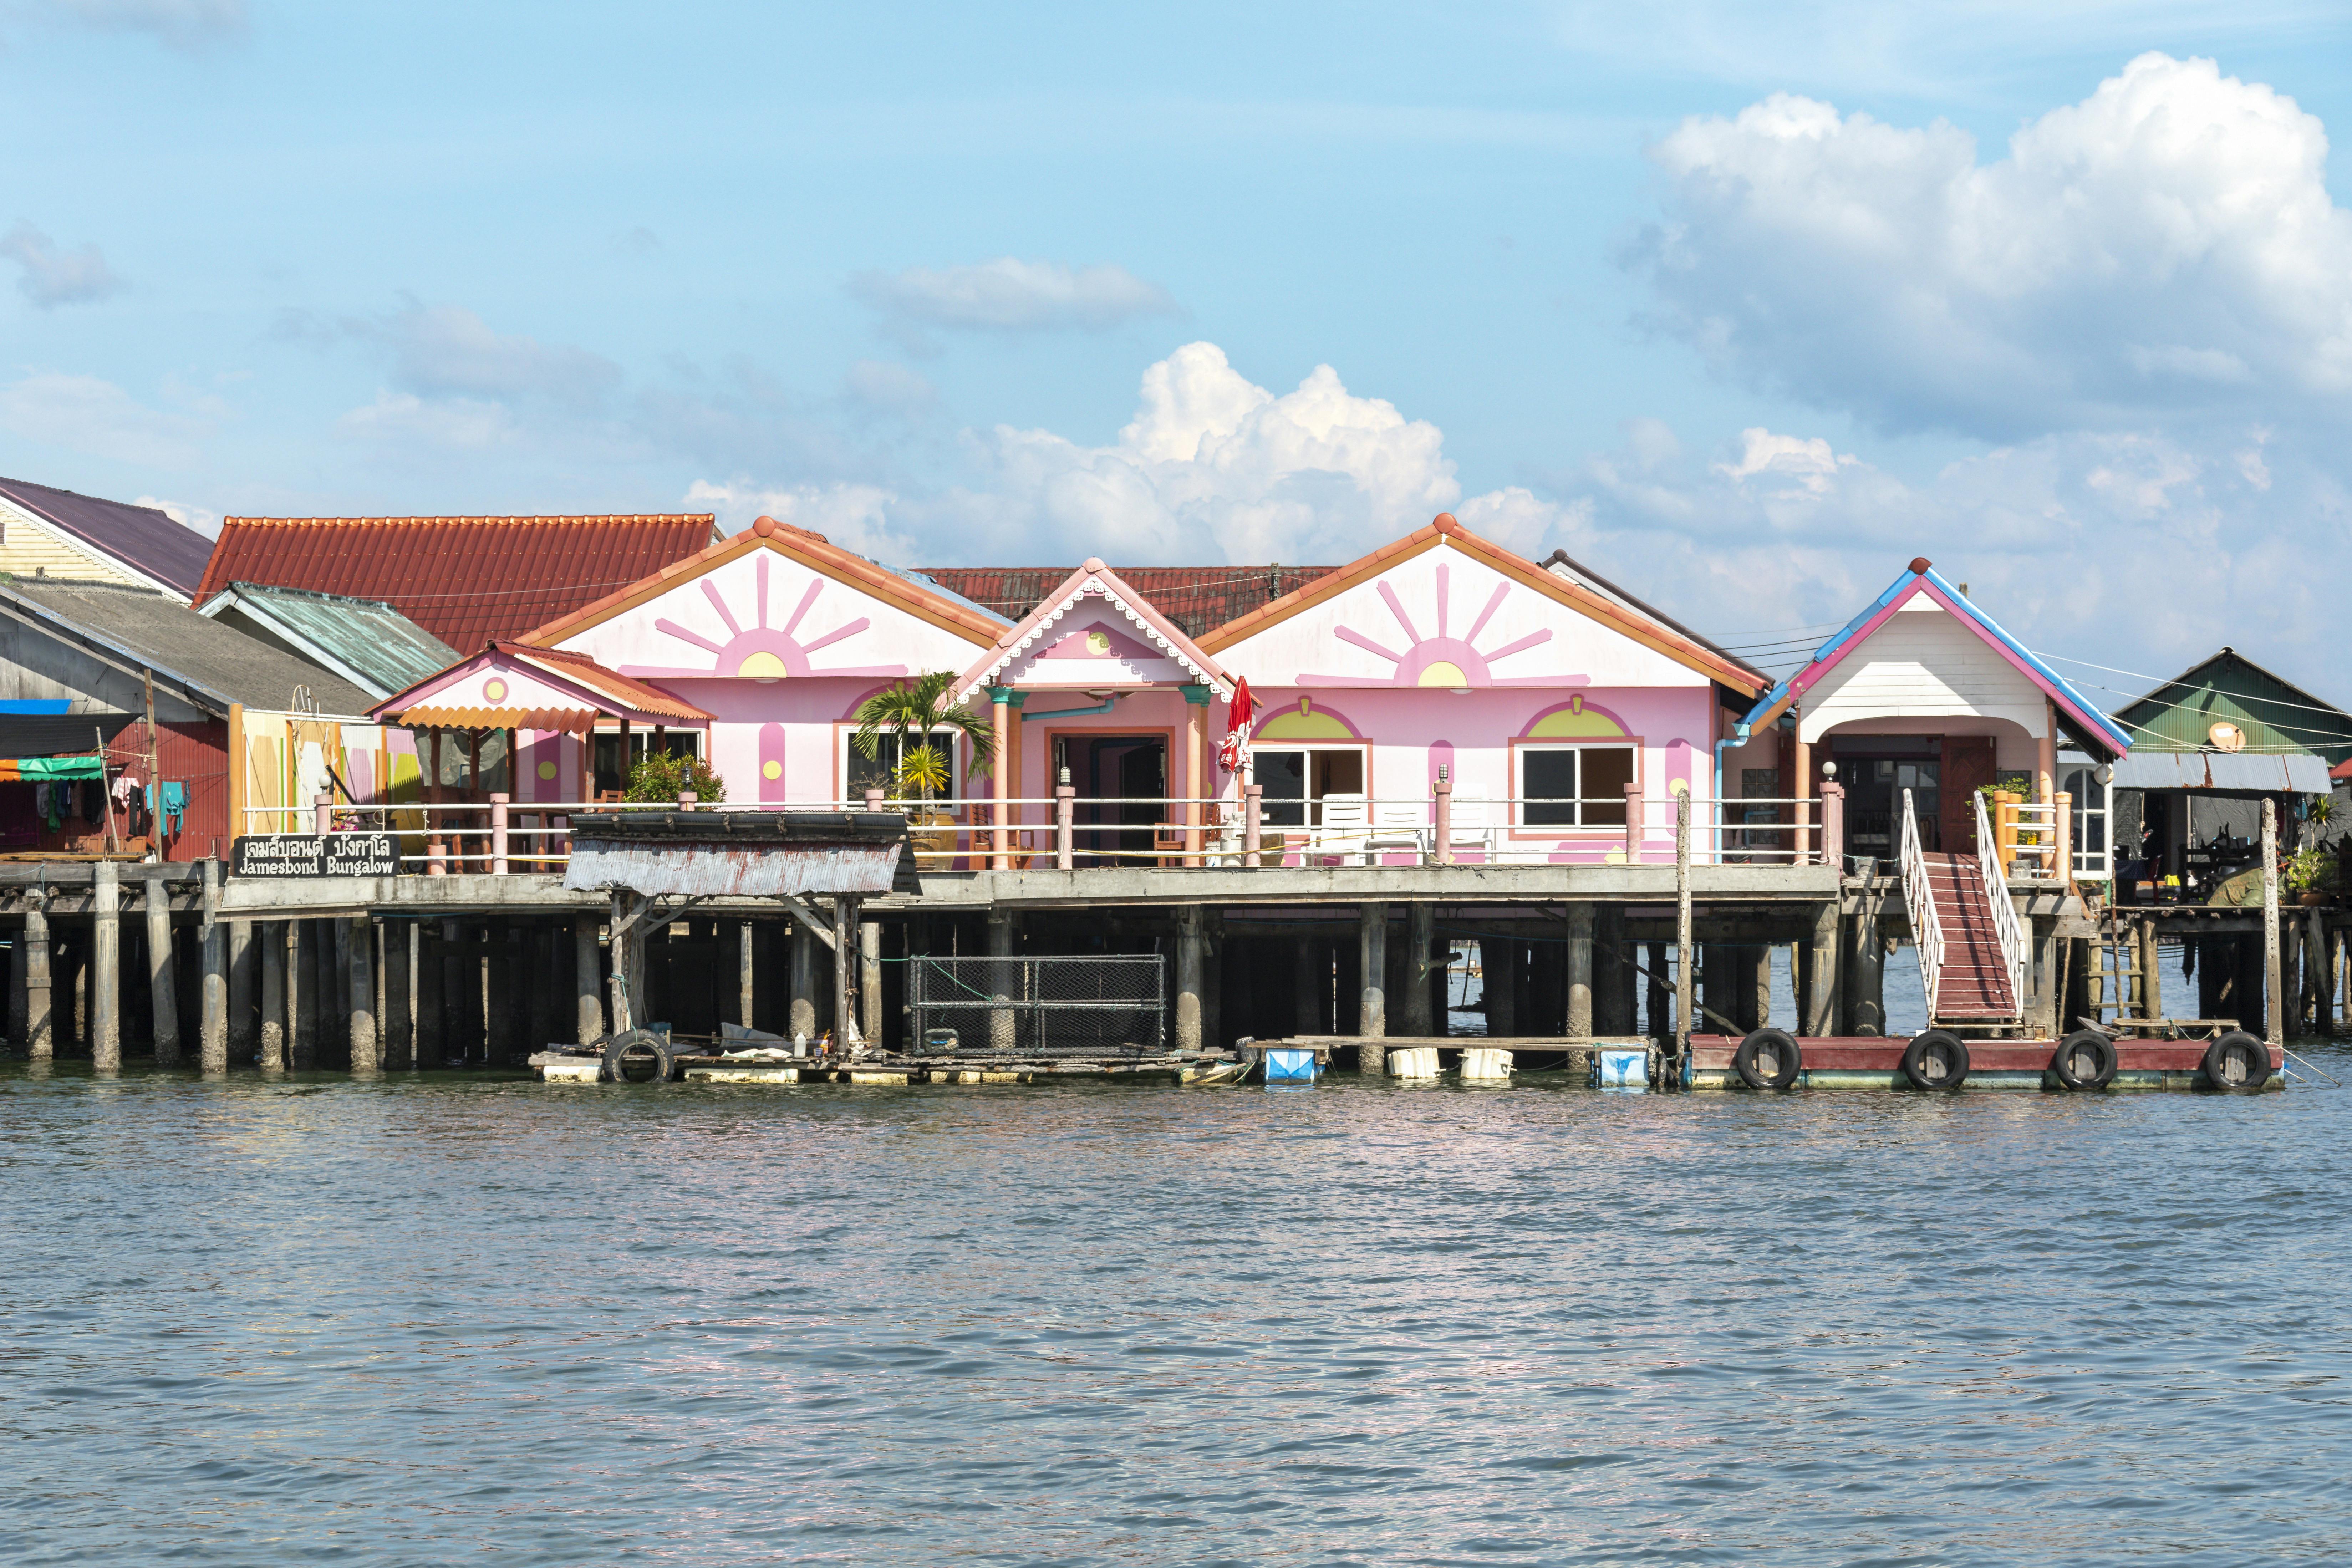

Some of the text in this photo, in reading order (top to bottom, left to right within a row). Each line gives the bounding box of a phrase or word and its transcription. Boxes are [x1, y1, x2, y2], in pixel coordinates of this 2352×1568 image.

[245, 834, 390, 857] เจมส์บอนด์ บังกาโล
[239, 856, 394, 876] Jamesbond Bungalow
